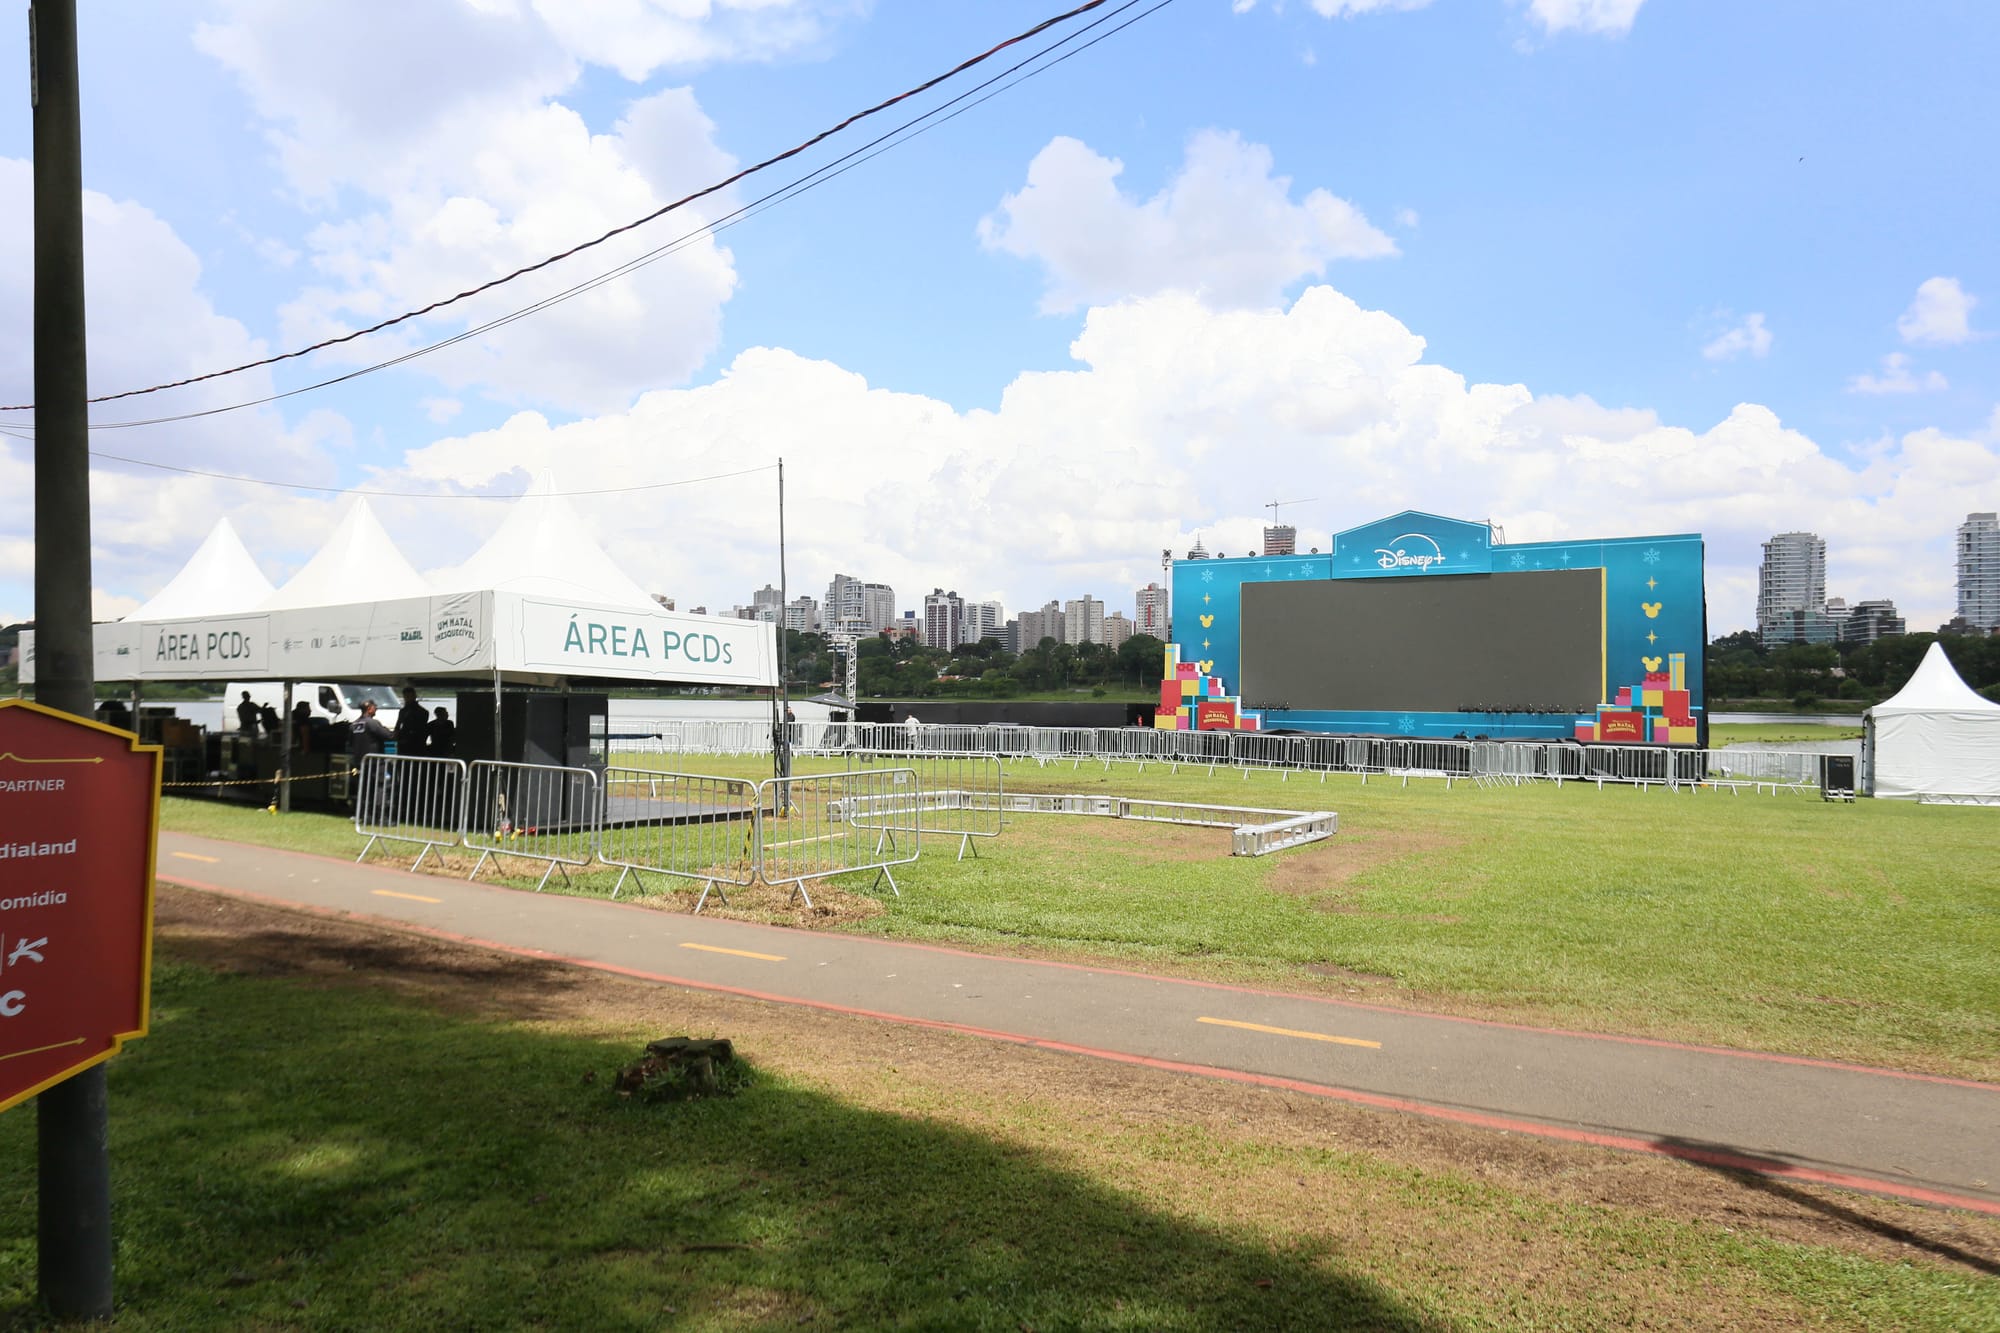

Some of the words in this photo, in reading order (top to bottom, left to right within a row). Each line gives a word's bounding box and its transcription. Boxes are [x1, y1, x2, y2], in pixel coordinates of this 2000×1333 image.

[1374, 548, 1446, 572] Disney+
[449, 617, 473, 628] NATAL
[563, 603, 650, 658] ÁREA
[663, 630, 733, 665] PCDs
[156, 628, 200, 661] ÁREA
[207, 631, 251, 660] PCDs
